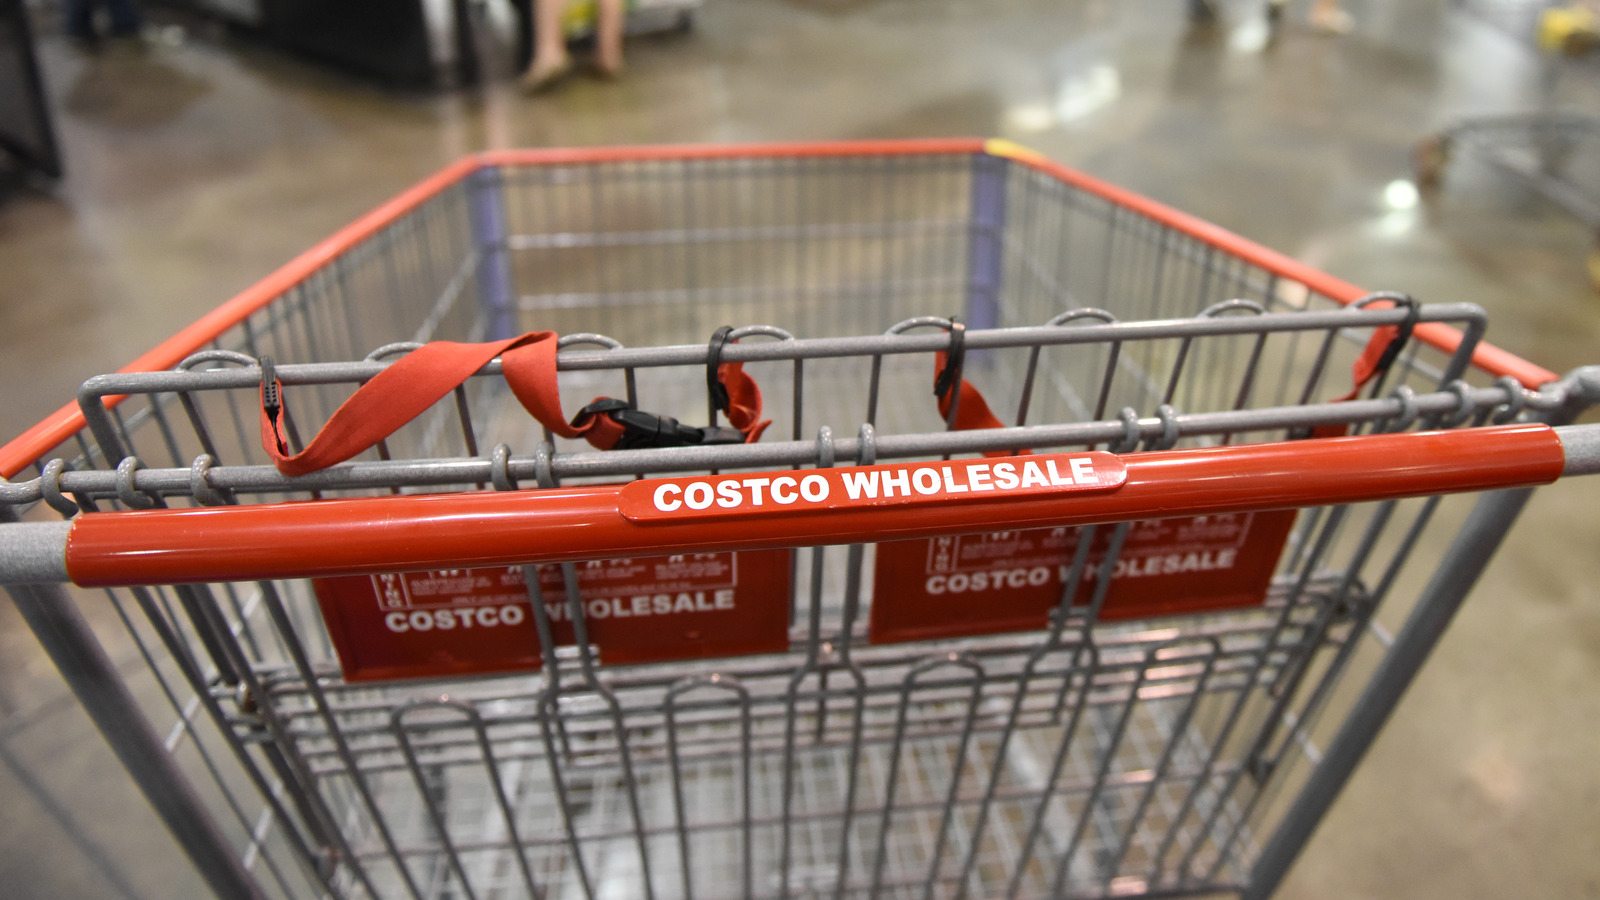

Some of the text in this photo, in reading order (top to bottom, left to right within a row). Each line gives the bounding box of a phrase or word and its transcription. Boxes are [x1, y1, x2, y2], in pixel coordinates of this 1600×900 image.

[653, 457, 1099, 512] COSTCO WHOLESALE
[925, 566, 1050, 595] COSTCO
[385, 604, 525, 633] COSTCO
